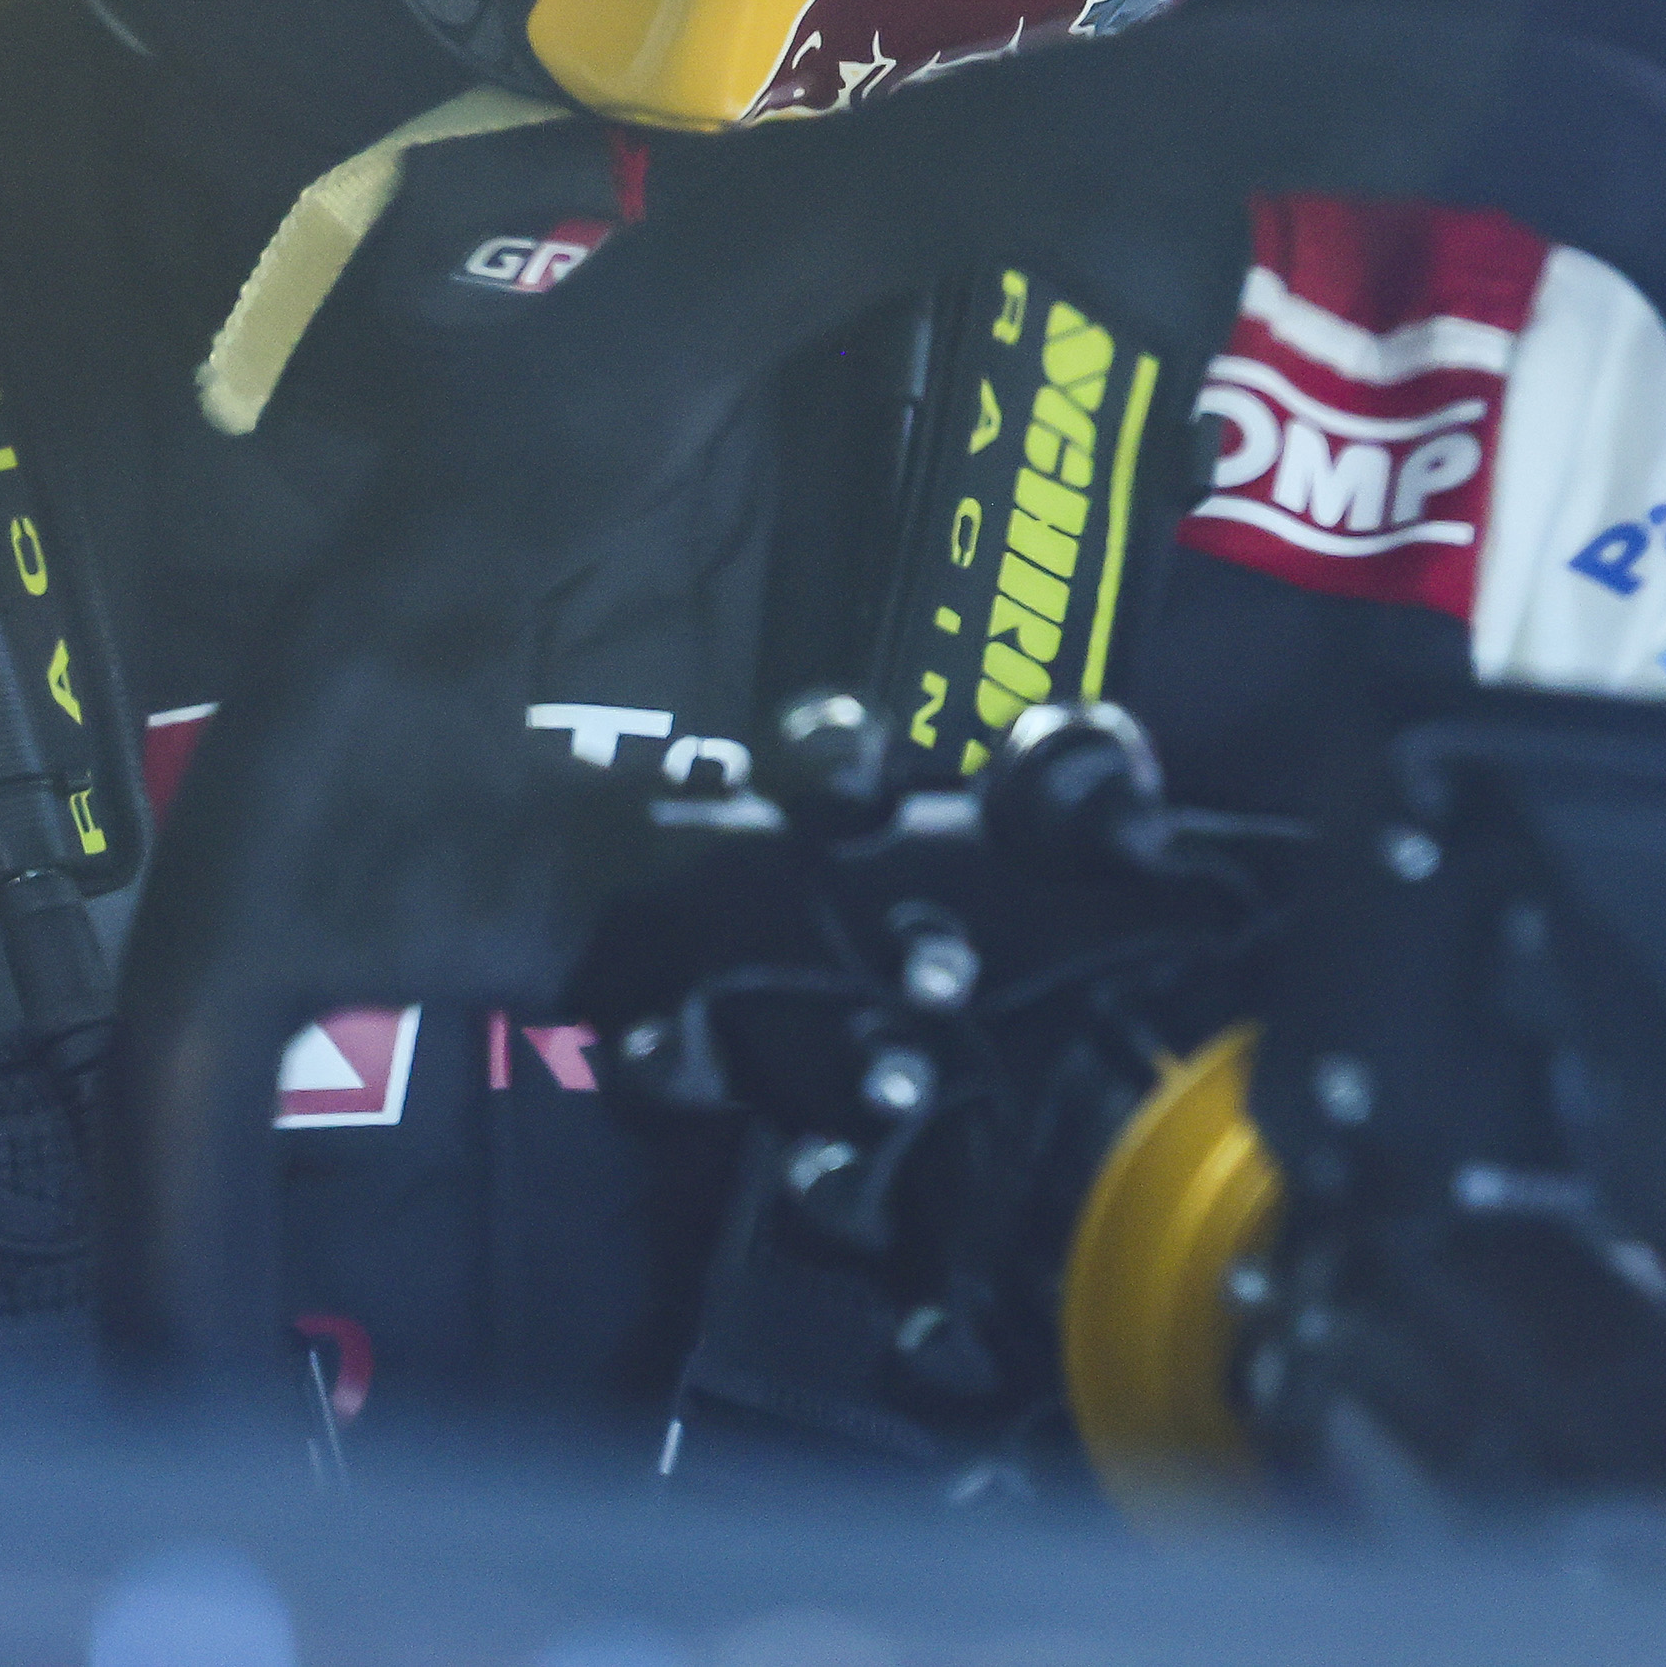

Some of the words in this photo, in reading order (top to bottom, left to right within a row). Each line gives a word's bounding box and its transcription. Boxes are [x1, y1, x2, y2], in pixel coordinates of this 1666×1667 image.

[463, 236, 590, 285] GR
[909, 268, 1029, 750] RACIN
[959, 300, 1115, 776] SCHRO
[1190, 386, 1483, 533] OMP
